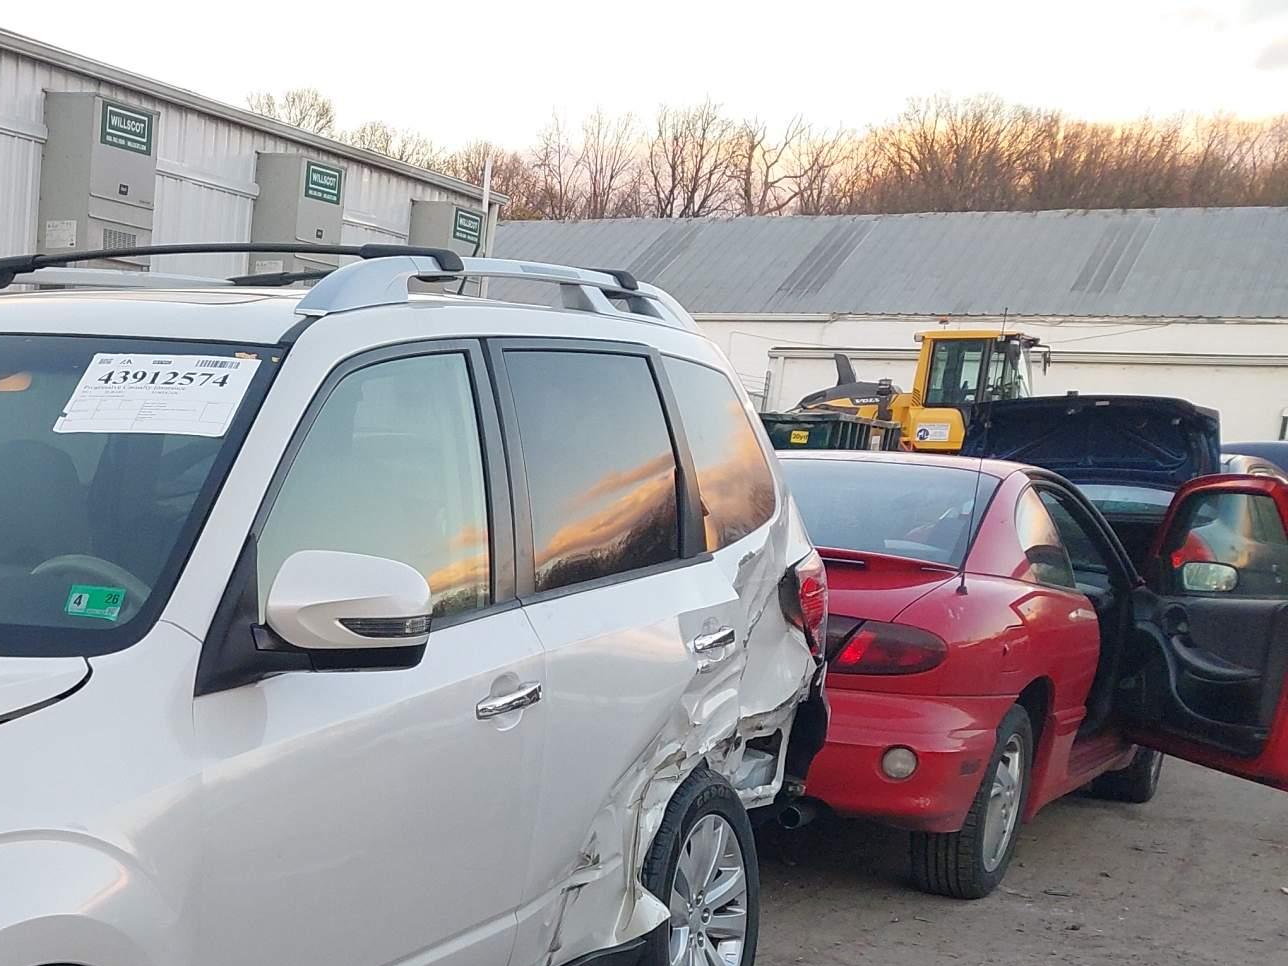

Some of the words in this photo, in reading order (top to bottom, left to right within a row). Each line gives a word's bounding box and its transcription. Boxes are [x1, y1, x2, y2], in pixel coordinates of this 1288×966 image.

[110, 114, 145, 134] WILLSCOT
[312, 172, 336, 189] WILLSCOT
[98, 369, 230, 388] 43912574
[73, 594, 84, 607] 4
[104, 592, 120, 605] 26
